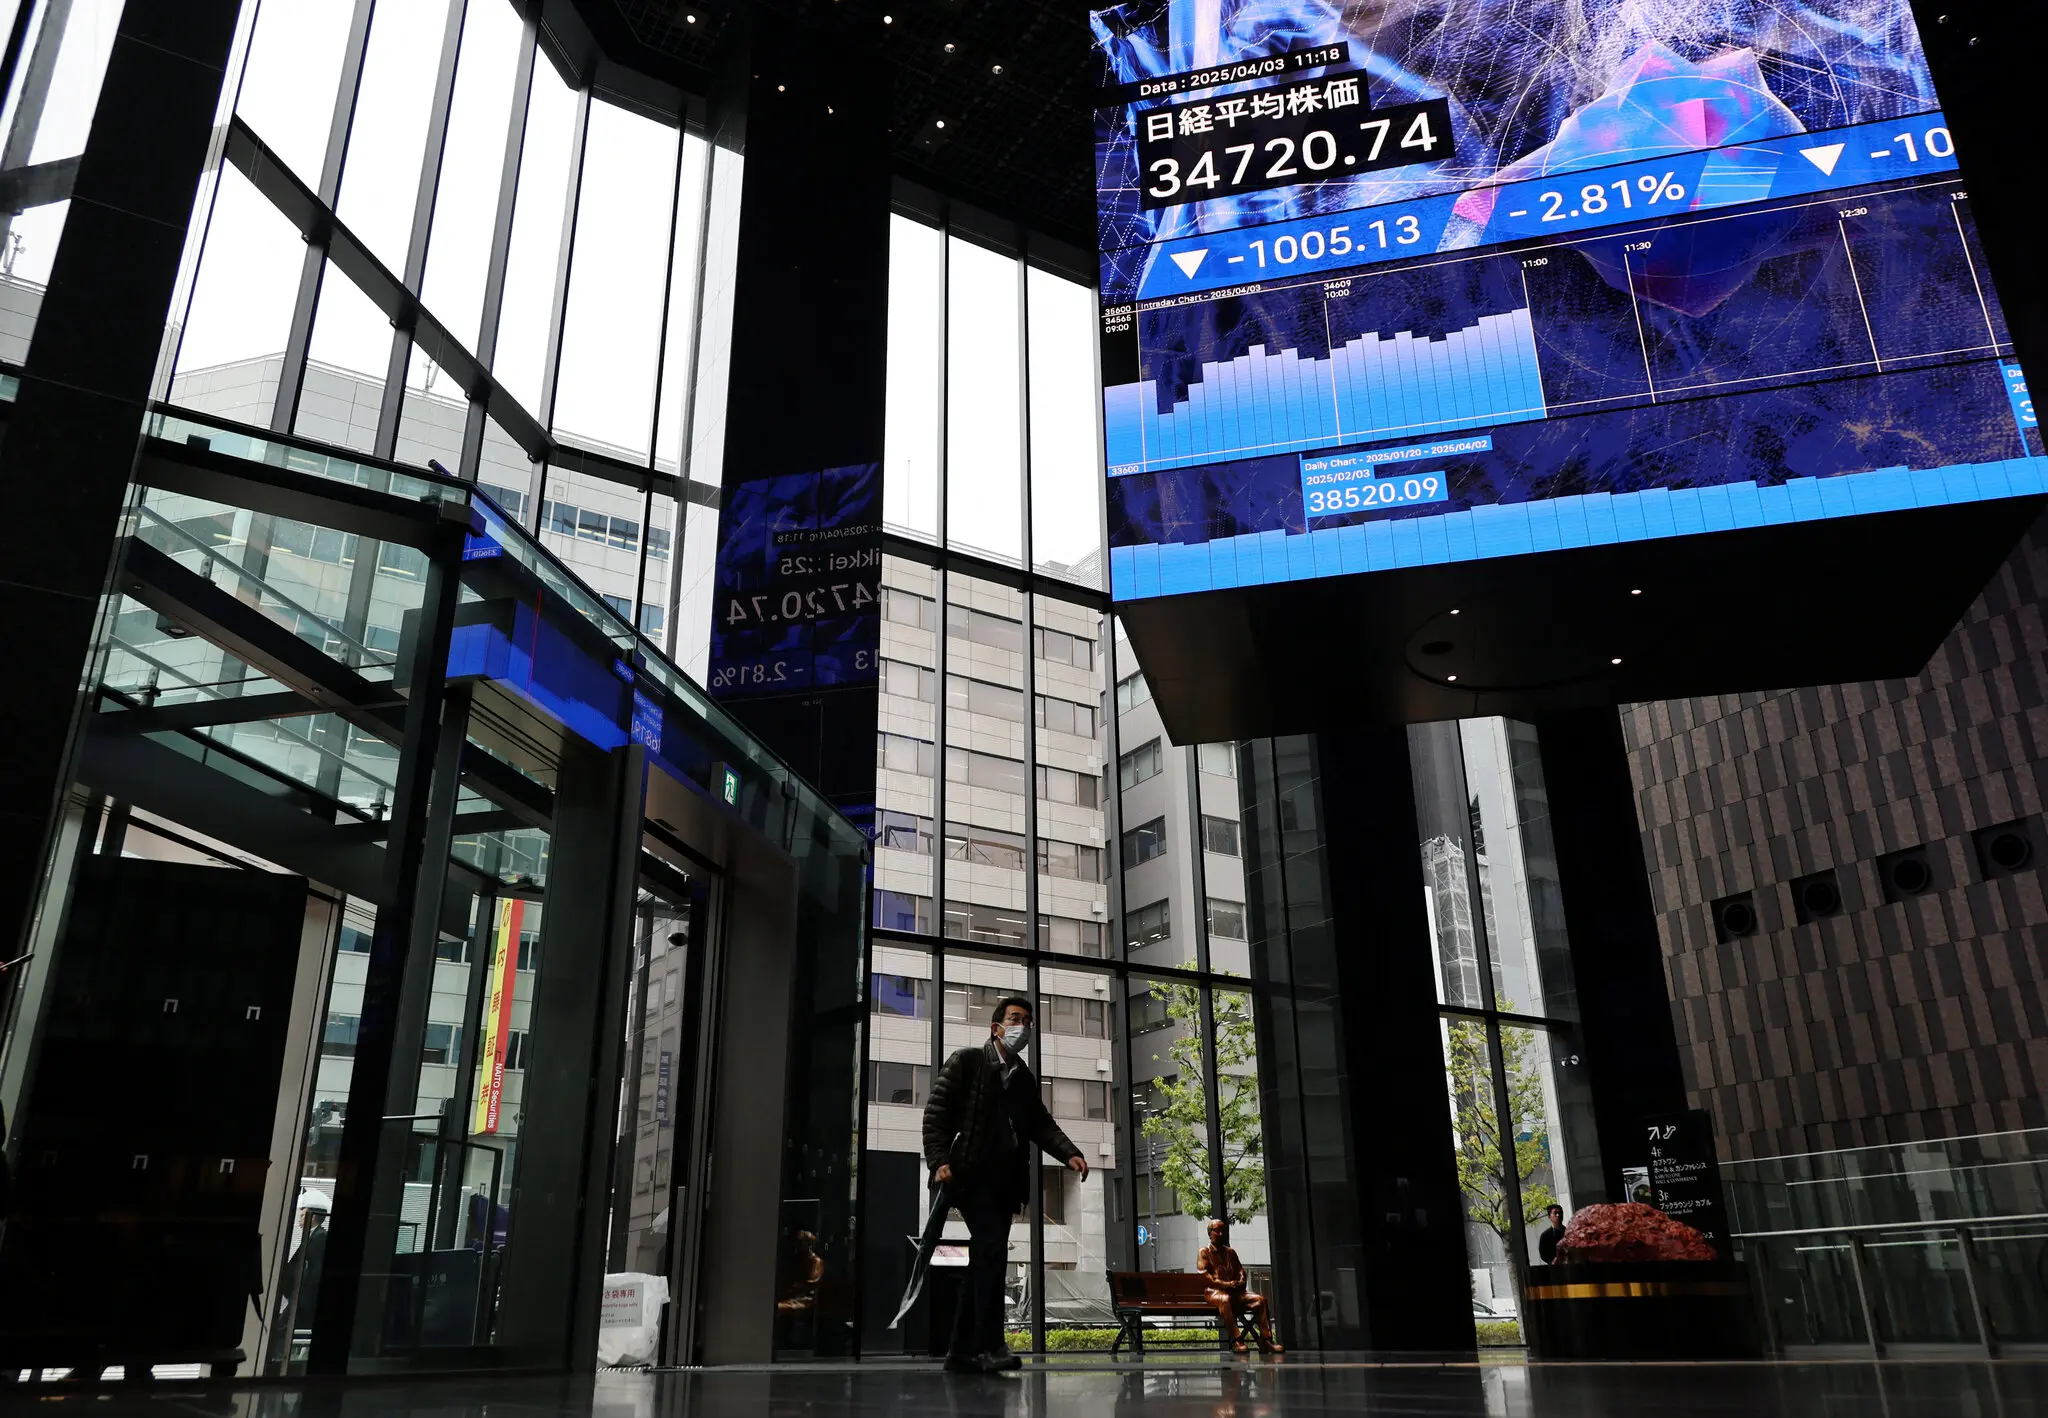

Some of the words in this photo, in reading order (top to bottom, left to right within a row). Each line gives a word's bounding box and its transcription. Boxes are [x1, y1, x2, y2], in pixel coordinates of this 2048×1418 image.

[1140, 79, 1177, 96] Data
[1190, 59, 1285, 87] 2025/04/03
[1295, 48, 1340, 67] 11:18
[1146, 77, 1360, 143] 日経平均株価
[1148, 112, 1438, 198] 34720.74
[1839, 206, 1868, 219] 12:30
[1227, 215, 1421, 270] -1005.13
[1623, 240, 1652, 253] 11:30
[1521, 257, 1549, 269] 11:00
[1323, 279, 1351, 290] 34609
[1141, 298, 1176, 310] Intraday
[1178, 294, 1203, 304] Chart
[1210, 284, 1261, 299] 2025/04/03
[1324, 288, 1350, 299] 10:00
[1104, 305, 1132, 316] 35600
[1105, 314, 1132, 325] 34565
[1105, 323, 1130, 334] 09:00
[1305, 460, 1328, 471] Daily
[1330, 457, 1357, 468] Chart
[1366, 448, 1422, 463] 2025/01/20
[1431, 440, 1488, 455] 2025/04/02
[1111, 464, 1140, 476] 33600
[1306, 470, 1371, 486] 2025/02/03
[1309, 477, 1439, 513] 38520.09
[493, 1062, 503, 1089] NAITO
[487, 1089, 500, 1129] Securities
[1651, 1146, 1662, 1157] 4F
[1658, 1189, 1669, 1202] 3F
